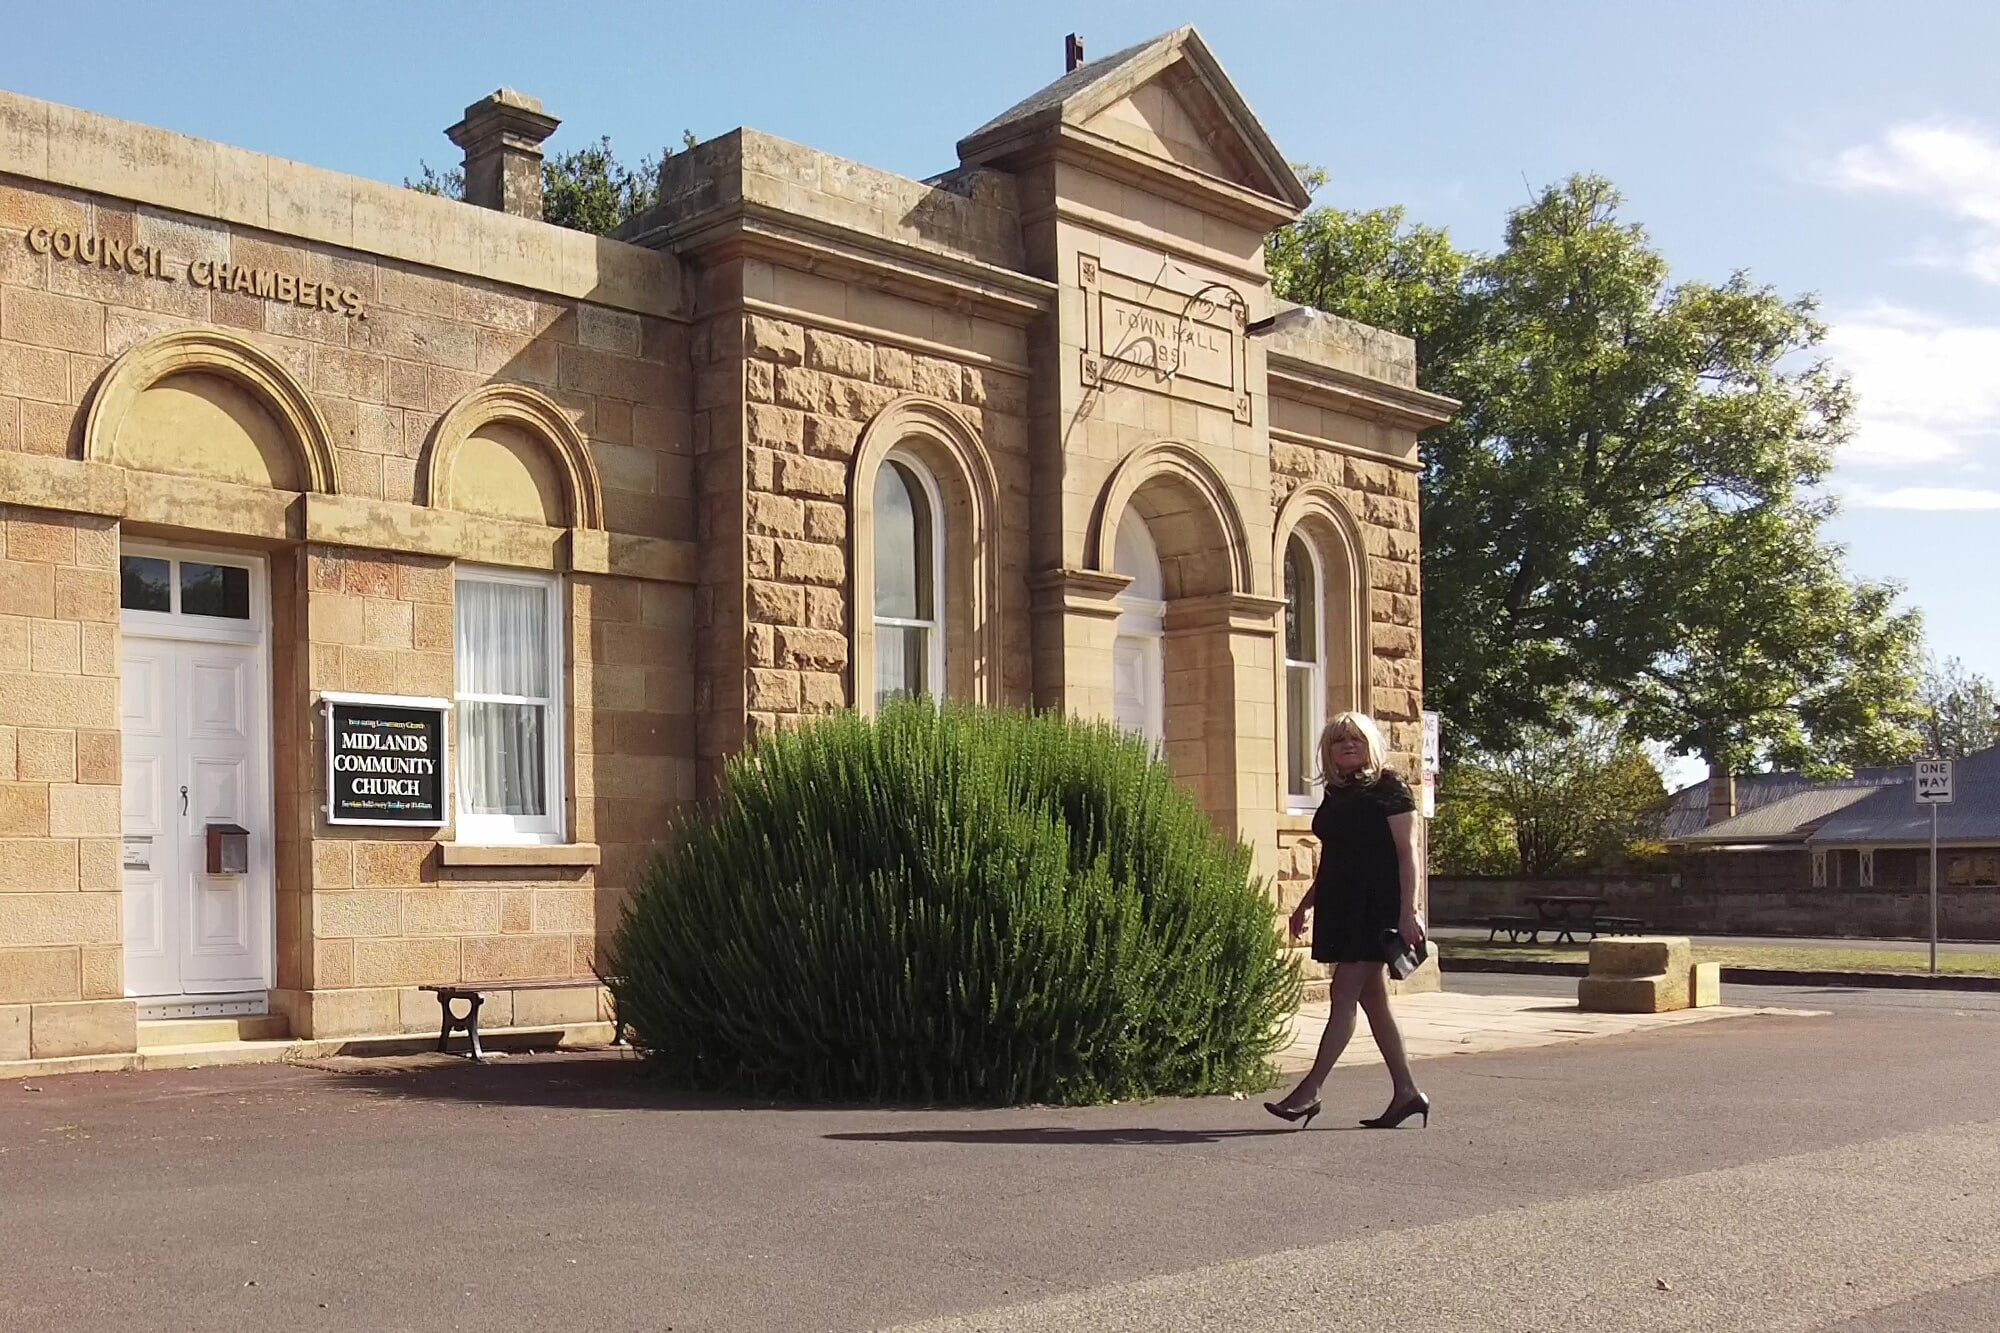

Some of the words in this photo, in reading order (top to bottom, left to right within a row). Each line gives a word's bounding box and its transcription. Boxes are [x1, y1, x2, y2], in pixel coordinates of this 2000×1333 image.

[27, 226, 174, 281] COUNCIL
[1422, 719, 1434, 731] NE
[341, 732, 428, 752] MIDLANDS
[334, 754, 436, 775] COMMUNITY
[1920, 763, 1948, 774] ONE
[351, 777, 420, 796] CHURCH
[1919, 776, 1949, 788] WAY
